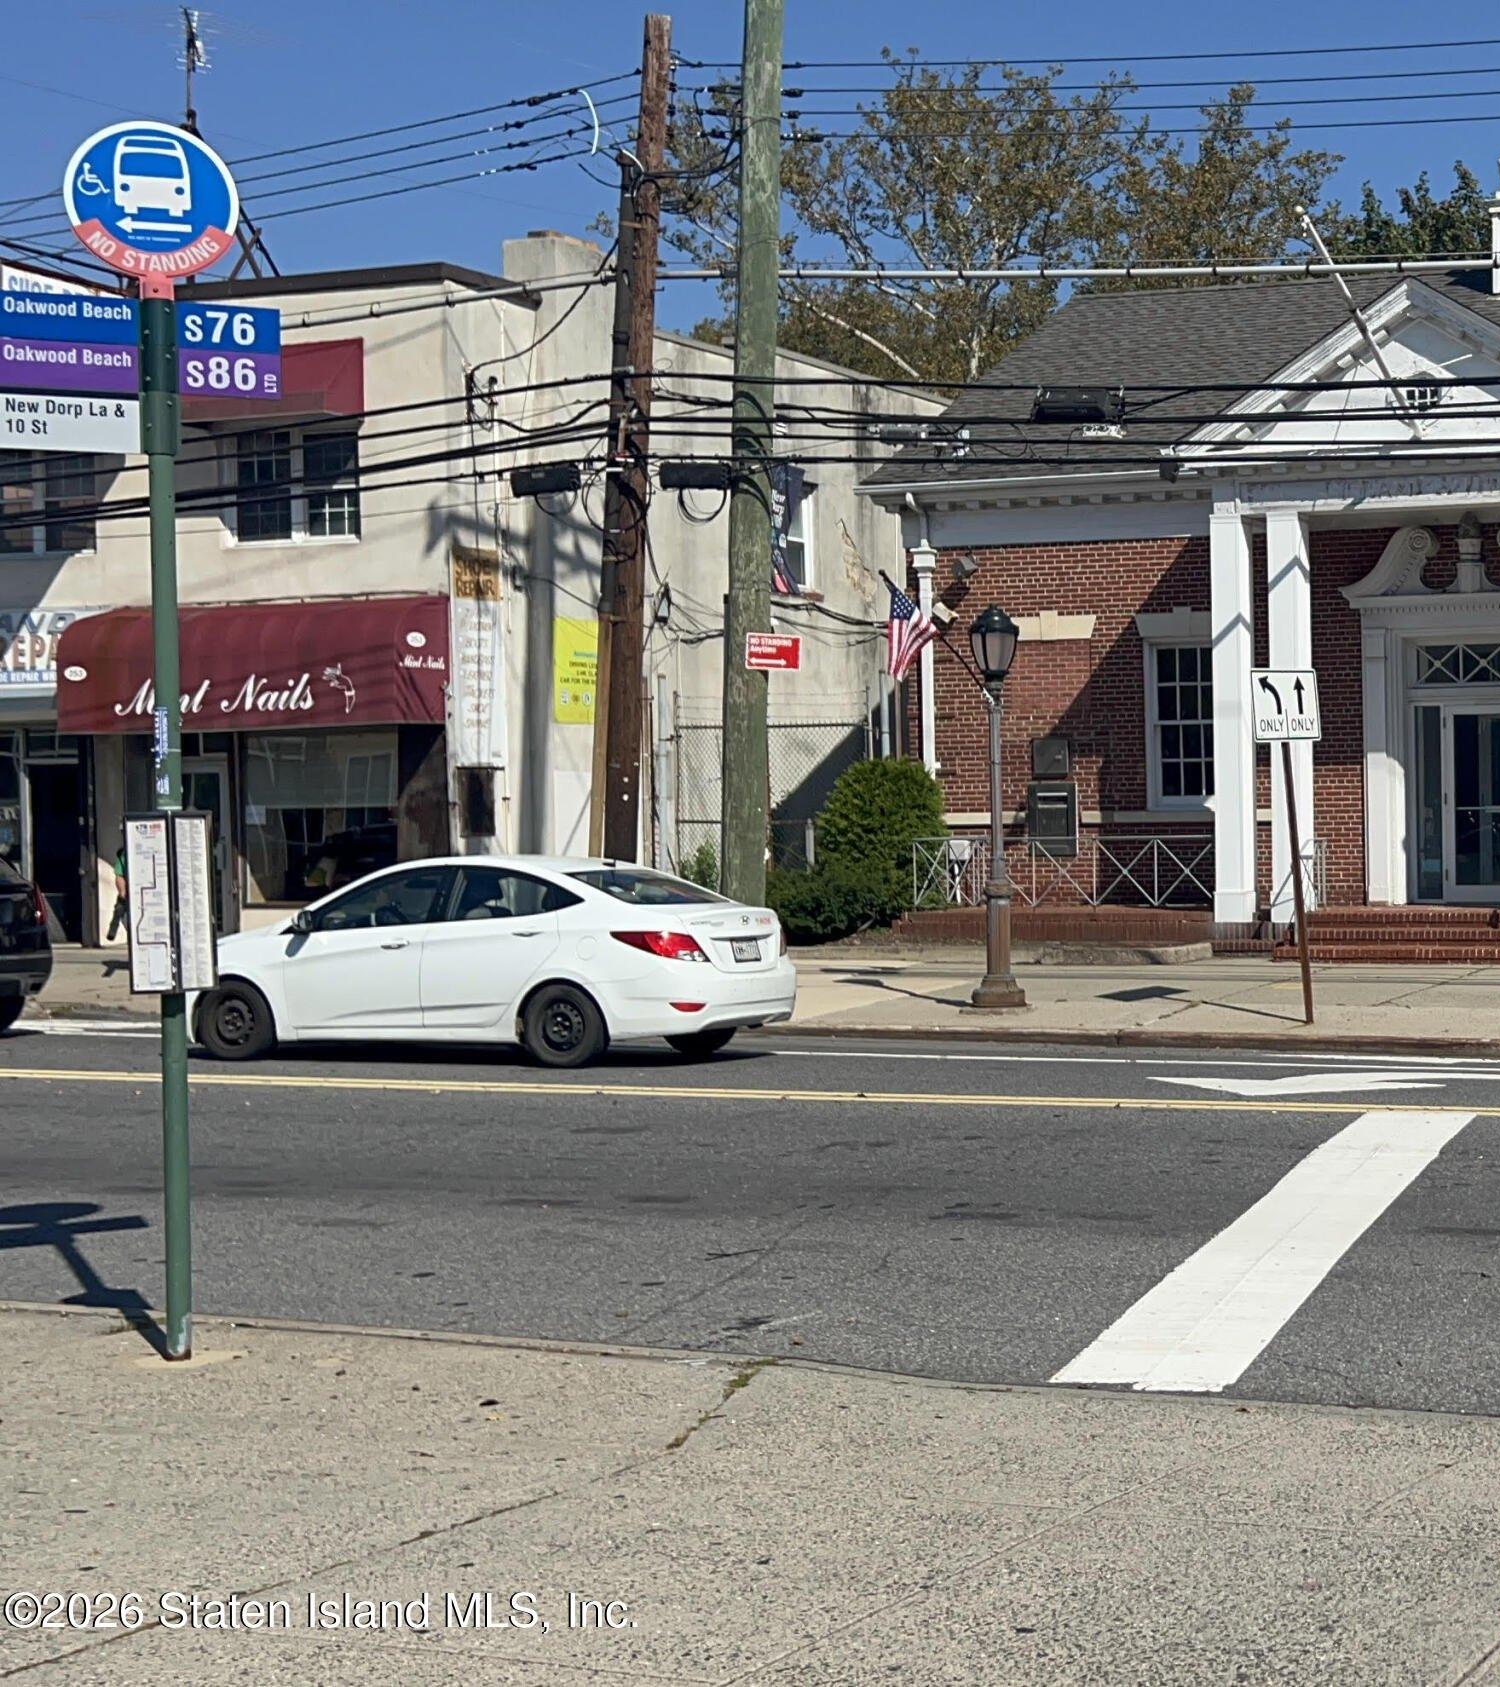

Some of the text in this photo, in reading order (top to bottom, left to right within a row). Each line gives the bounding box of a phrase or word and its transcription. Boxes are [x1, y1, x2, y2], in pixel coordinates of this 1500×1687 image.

[86, 230, 220, 273] NO STANDING
[3, 296, 132, 320] Oakwood Beach
[185, 311, 256, 346] S76
[3, 344, 132, 368] Oakwood Beach
[186, 356, 257, 391] S86
[263, 373, 277, 393] LTD
[5, 398, 126, 420] New Dorp La &
[6, 419, 48, 435] 10 St
[456, 556, 492, 577] SHOE
[456, 577, 495, 598] REPAIR
[751, 637, 792, 647] NO STANDING
[114, 673, 315, 716] Mnt Nails
[1260, 718, 1315, 732] ONLY ONLY
